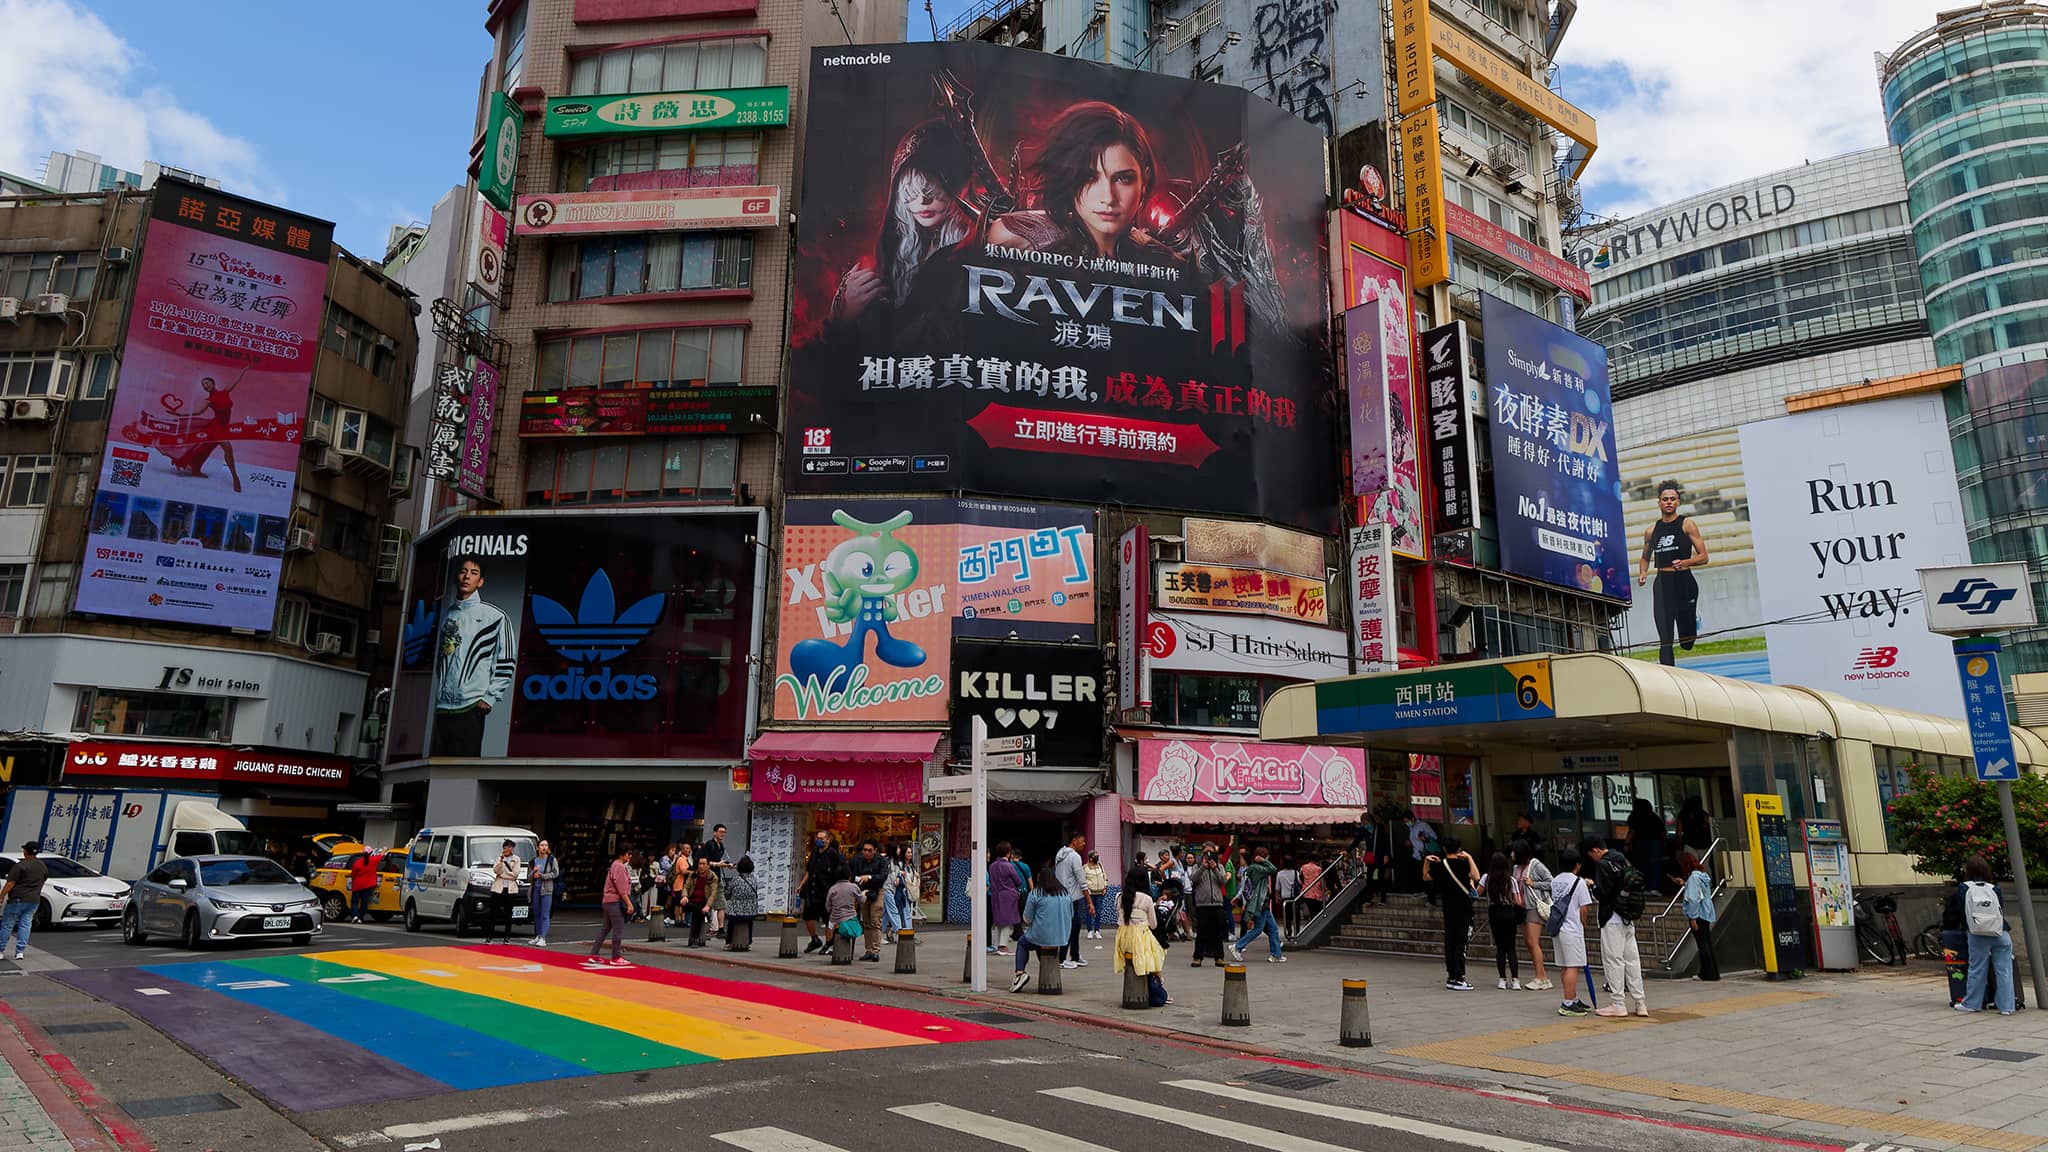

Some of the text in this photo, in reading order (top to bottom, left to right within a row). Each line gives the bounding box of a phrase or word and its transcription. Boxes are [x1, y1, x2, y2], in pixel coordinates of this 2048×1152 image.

[823, 52, 891, 67] netmarble
[1405, 43, 1418, 86] HOTEL
[1516, 79, 1545, 105] HOTEL
[561, 118, 588, 128] SPA
[614, 99, 717, 121] 詩薇思
[736, 110, 784, 123] 2388-8155
[1412, 134, 1428, 197] 陸號行旅
[746, 201, 765, 211] 6F
[178, 196, 311, 250] 諾亞媒體
[1505, 239, 1533, 263] HOTEL
[150, 300, 217, 324] 11/1-11/30
[961, 263, 1199, 332] RAVEN
[1051, 319, 1113, 351] 渡鴉
[1507, 348, 1585, 394] Simply 新普利
[1104, 371, 1298, 431] 成為真正的我
[1431, 376, 1459, 441] 駭客
[1014, 418, 1177, 453] 立即進行事前預約
[816, 460, 829, 468] App
[868, 457, 906, 467] Google Play
[1805, 477, 1898, 515] Run
[958, 525, 1090, 584] 西門町
[1809, 532, 1906, 579] your
[961, 584, 1032, 603] XIMEN-WALKER
[1231, 573, 1264, 596] 按摩
[1358, 555, 1381, 601] 按摩
[1820, 587, 1910, 628] way.
[1231, 634, 1281, 655] Hair
[1285, 639, 1332, 665] Salon
[1360, 618, 1383, 665] 護膚
[197, 676, 224, 690] Hair
[227, 677, 261, 692] Salon
[522, 666, 657, 701] adidas
[960, 670, 1096, 702] KILLER
[1844, 669, 1911, 681] new balance
[775, 664, 945, 720] Welcome
[1394, 681, 1455, 707] 西門站
[1516, 674, 1540, 710] 6
[1966, 679, 1987, 729] 服務中心
[1983, 685, 2002, 722] 旅遊
[1394, 706, 1458, 719] XIMEN STATION
[1974, 738, 2011, 746] Information
[74, 751, 108, 766] J&G
[233, 759, 343, 779] JIGUANG FRIED CHICKEN
